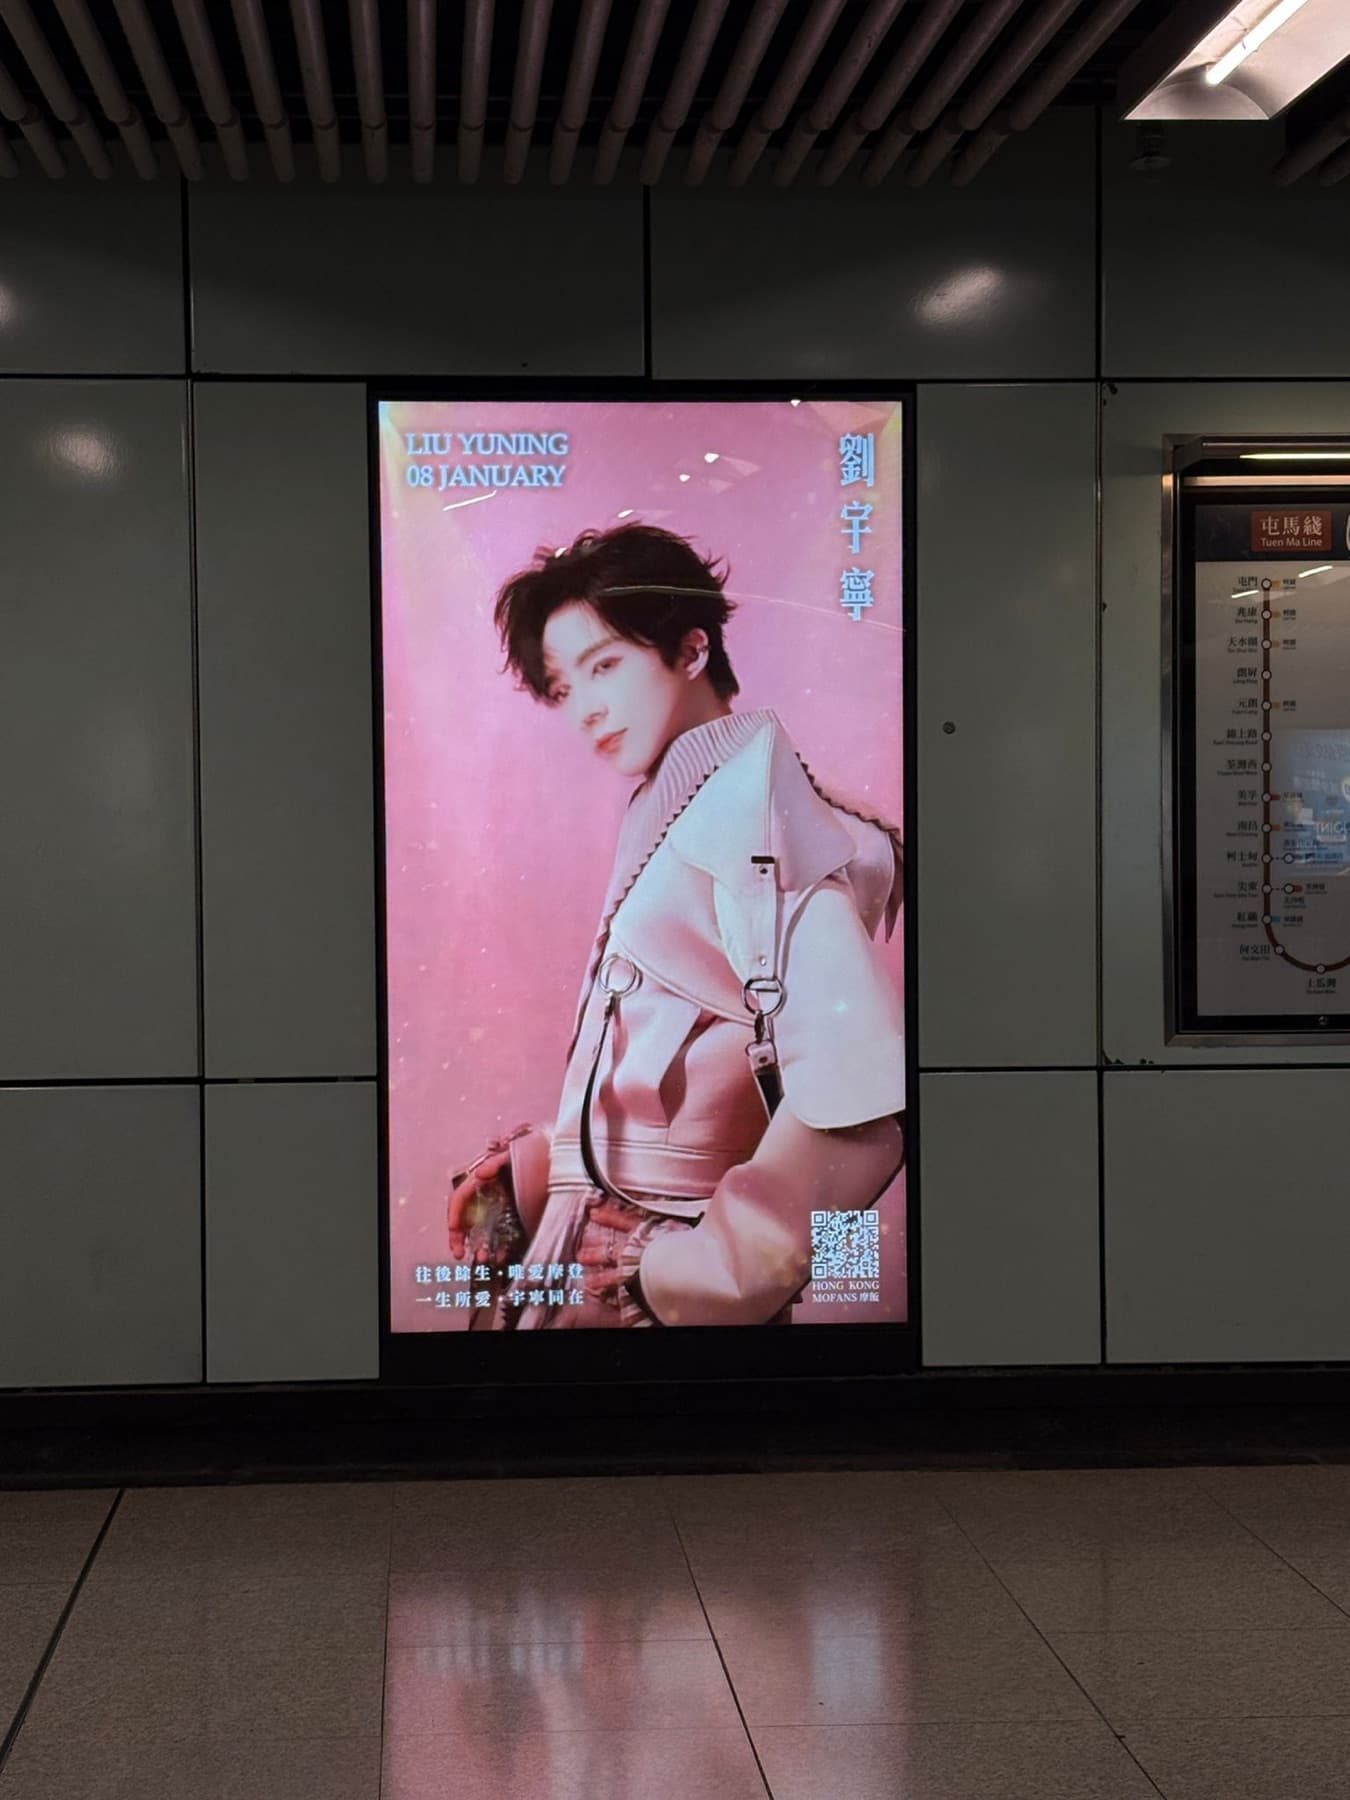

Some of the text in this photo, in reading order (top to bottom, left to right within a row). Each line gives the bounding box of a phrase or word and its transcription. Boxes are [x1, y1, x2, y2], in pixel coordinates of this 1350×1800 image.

[406, 432, 569, 455] LIU YUNING
[406, 464, 566, 491] 08 JANUARY
[839, 432, 876, 621] 劉宇寧
[1261, 538, 1322, 547] Tuen Ma Line
[812, 1280, 880, 1291] HONG KONG
